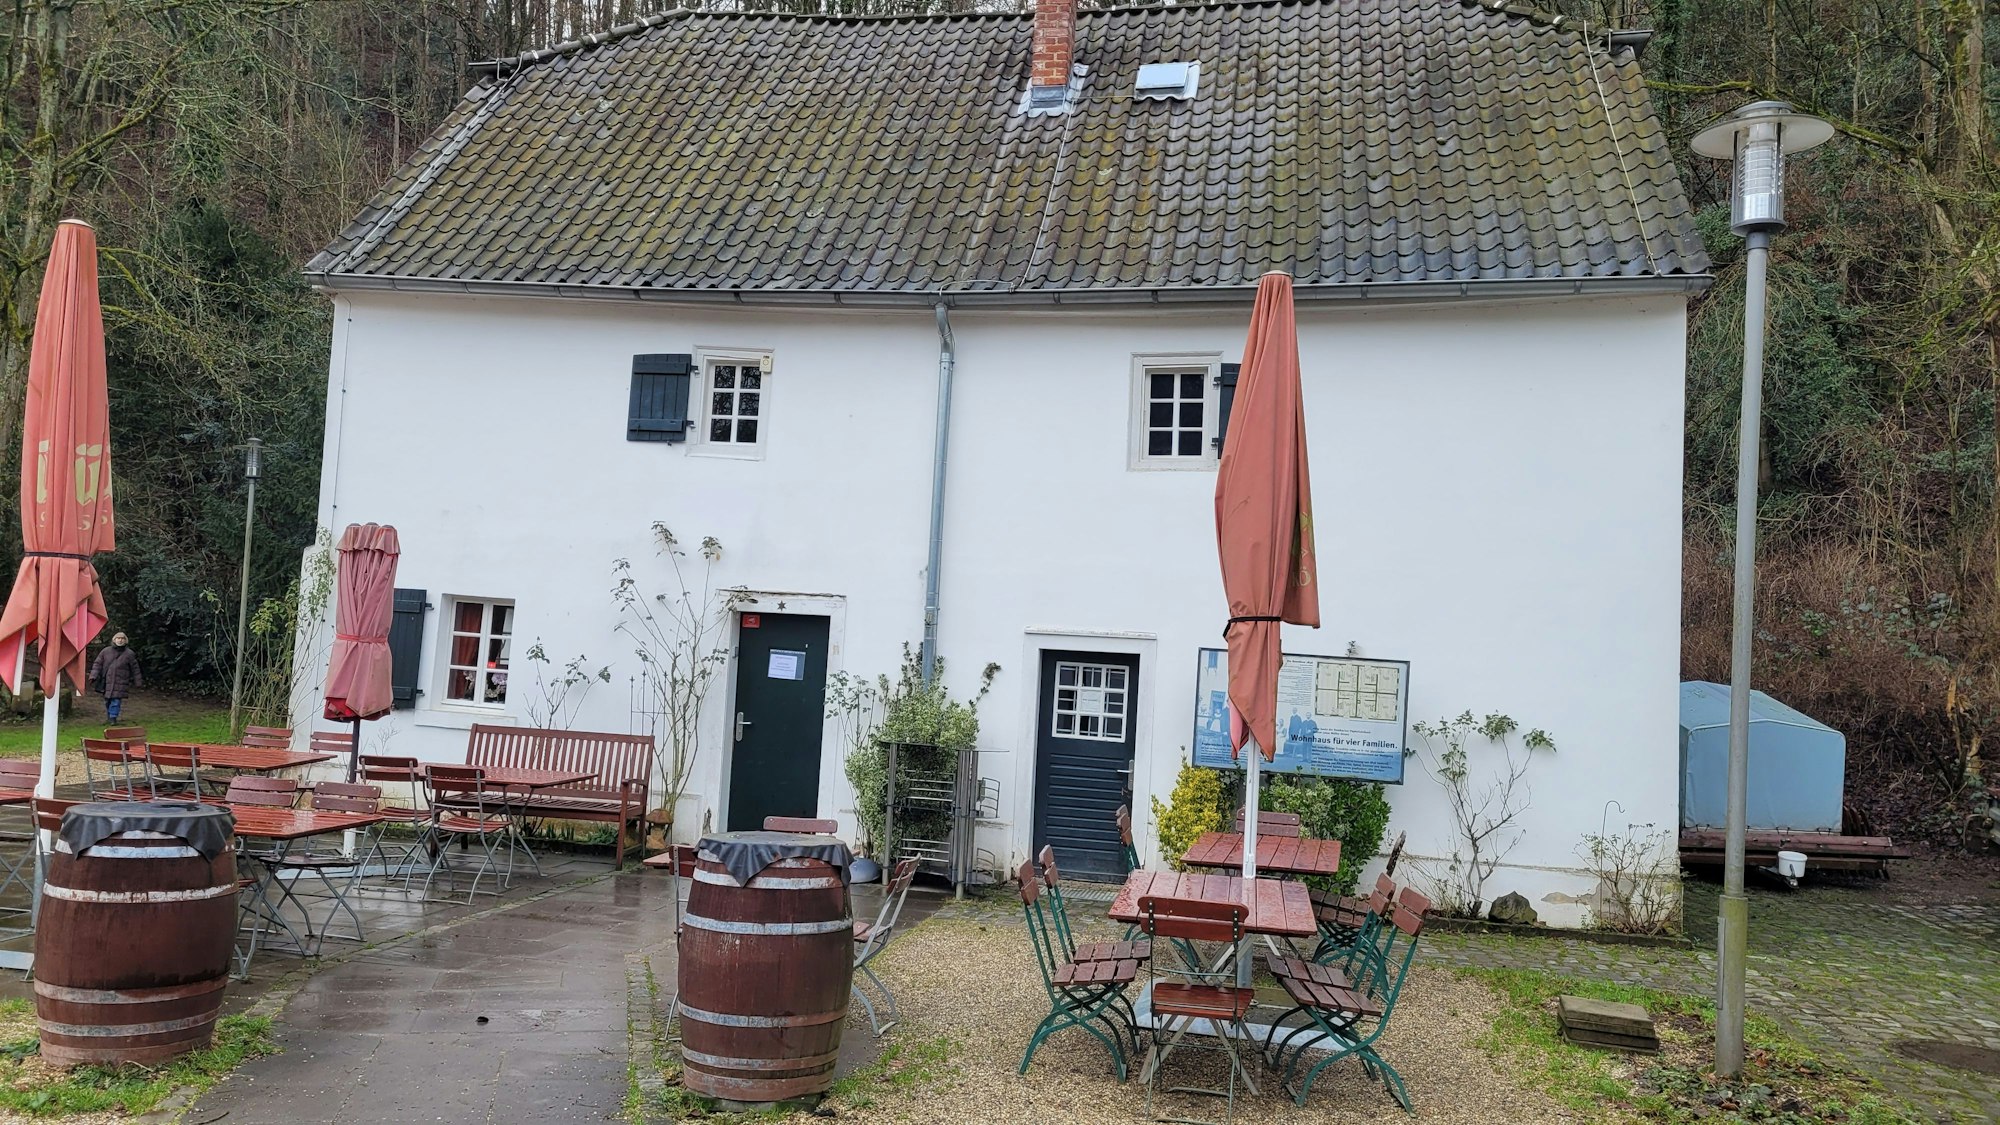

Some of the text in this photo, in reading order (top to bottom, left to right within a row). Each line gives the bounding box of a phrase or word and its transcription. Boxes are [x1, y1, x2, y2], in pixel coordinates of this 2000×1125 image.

[1290, 734, 1331, 744] Wohnhaus
[1333, 736, 1344, 745] für
[1346, 738, 1360, 747] vier
[1362, 739, 1398, 749] Familien.
